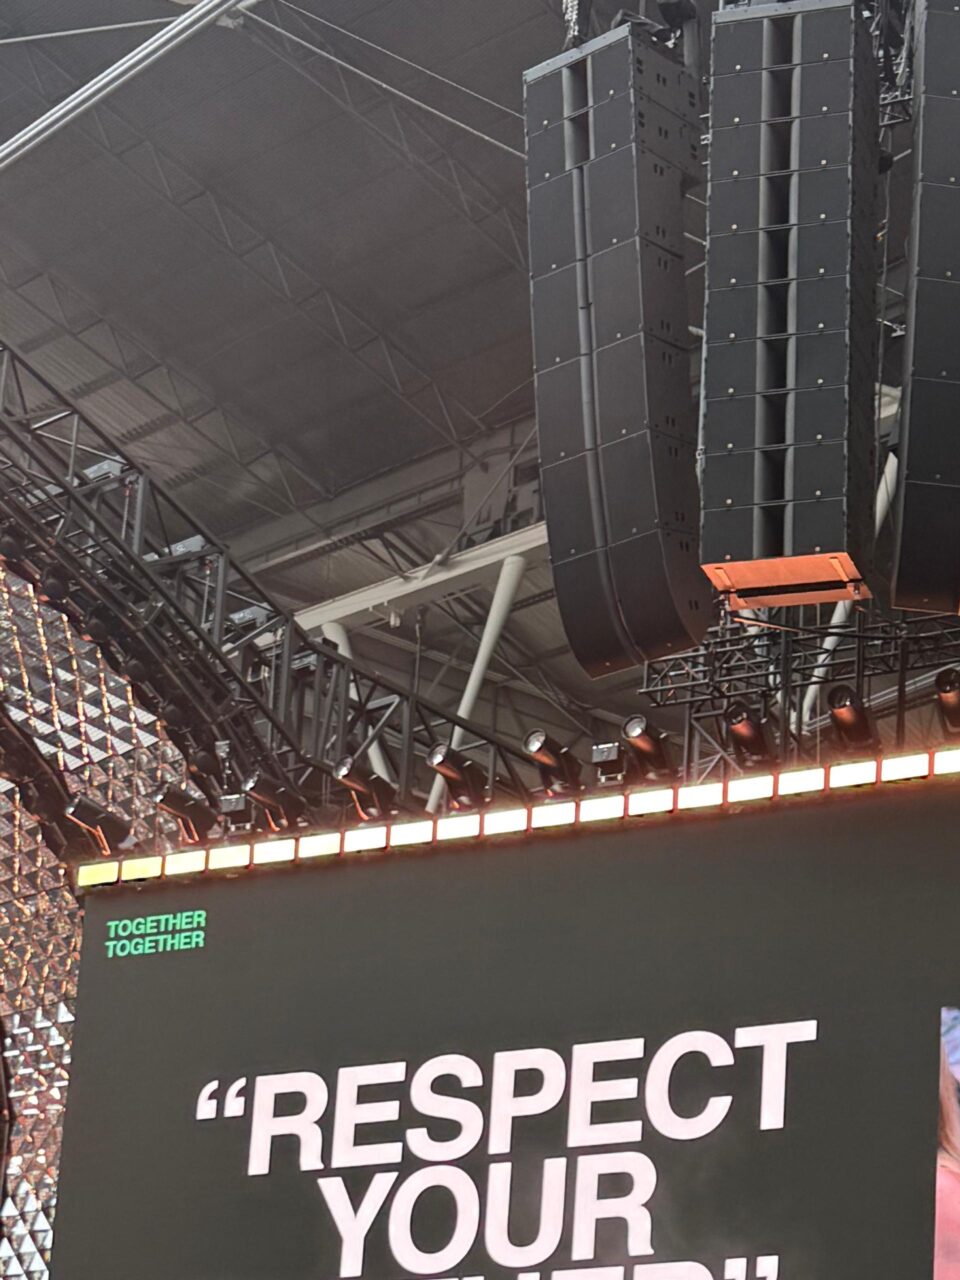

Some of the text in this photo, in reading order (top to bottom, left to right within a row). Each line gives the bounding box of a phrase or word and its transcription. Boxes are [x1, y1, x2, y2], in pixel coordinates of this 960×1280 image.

[104, 930, 205, 958] TOGETHER
[106, 910, 207, 938] TOGETHER
[196, 1019, 818, 1176] “RESPECT
[317, 1151, 658, 1278] YOUR
